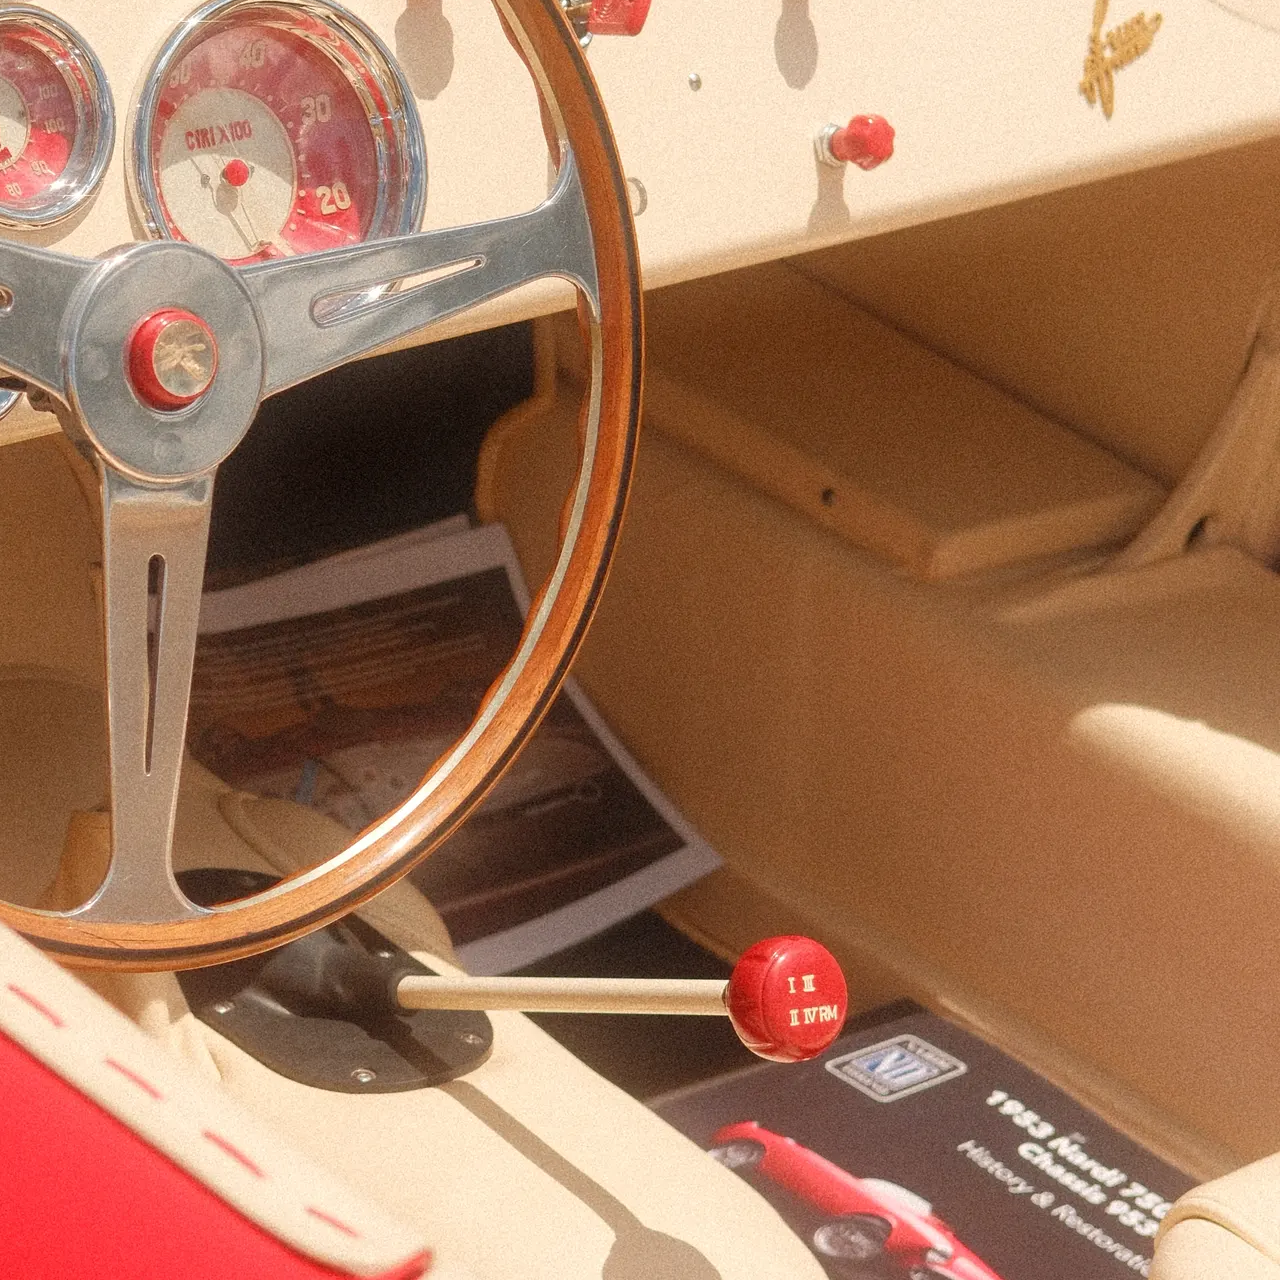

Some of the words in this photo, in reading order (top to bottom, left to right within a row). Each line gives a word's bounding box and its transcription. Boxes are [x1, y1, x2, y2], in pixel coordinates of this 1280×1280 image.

[301, 94, 331, 125] 30
[31, 160, 48, 176] 90
[5, 182, 21, 197] 80
[315, 180, 352, 216] 20
[787, 976, 796, 993] I
[801, 974, 816, 992] III
[789, 1008, 800, 1026] II
[986, 1089, 1055, 1139] 1953
[1047, 1135, 1128, 1187] Nardi
[956, 1139, 1035, 1195] History
[1030, 1190, 1056, 1209] &
[1018, 1141, 1107, 1205] Chassis
